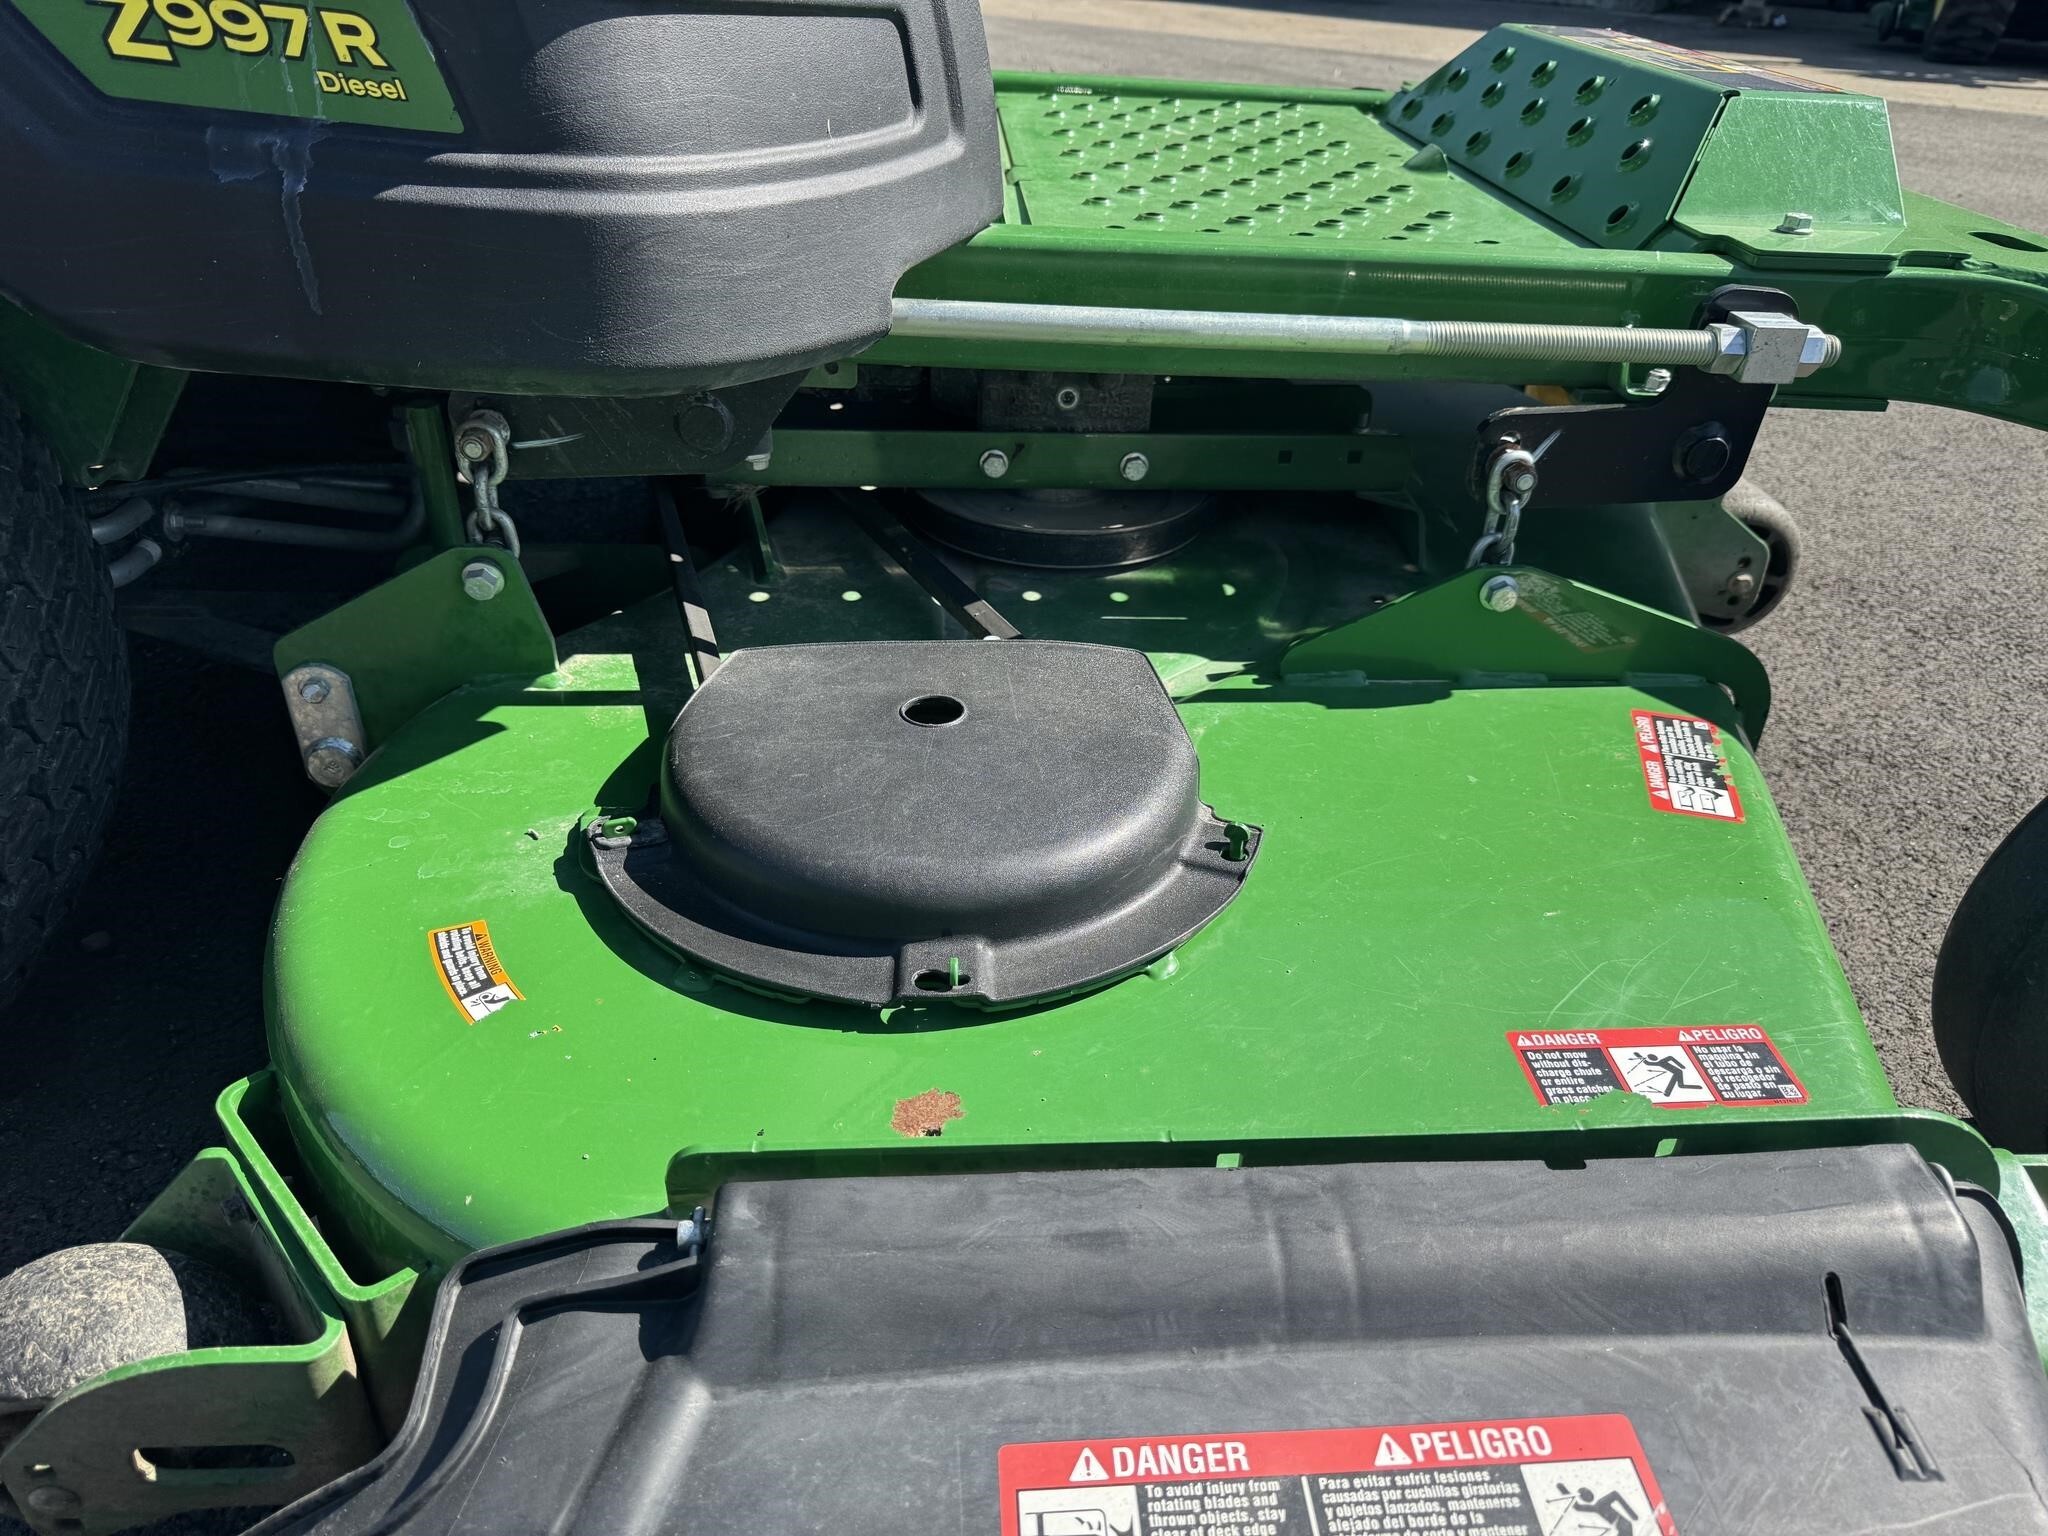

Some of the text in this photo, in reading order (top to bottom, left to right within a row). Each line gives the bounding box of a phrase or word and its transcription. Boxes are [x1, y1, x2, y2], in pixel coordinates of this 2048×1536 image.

[315, 70, 408, 100] Diesel
[1645, 761, 1665, 788] DANGER
[478, 941, 502, 975] WARNING
[1531, 1033, 1602, 1046] DANGER
[1690, 1028, 1762, 1041] PELIGRO
[1527, 1051, 1587, 1060] Do not mow
[1692, 1044, 1745, 1054] No usar la
[1743, 1051, 1760, 1059] sin
[1531, 1059, 1591, 1068] without dis-
[1714, 1060, 1738, 1068] tubo
[1739, 1059, 1753, 1067] de
[1536, 1067, 1602, 1078] charge chute
[1708, 1067, 1754, 1077] descarga
[1764, 1065, 1781, 1073] sin
[1541, 1077, 1585, 1086] or entire
[1711, 1074, 1776, 1084] el recogedor
[1545, 1085, 1614, 1097] grass catcher
[1717, 1081, 1778, 1092] de pasto en
[1721, 1090, 1766, 1099] su lugar.
[1410, 1425, 1552, 1462] PELIGRO
[1112, 1441, 1250, 1477] DANGER
[1319, 1470, 1490, 1490] Para evitar sufrir lesiones
[1145, 1479, 1280, 1498] To avoid injury from
[1322, 1482, 1520, 1504] causadas por cuchillas giratorias
[1147, 1493, 1278, 1513] rotating blades and
[1325, 1496, 1521, 1520] y objetos lanzados, mantenerse
[1149, 1507, 1286, 1528] thrown objects, stay
[1328, 1509, 1484, 1533] alejado del borde de la
[1190, 1525, 1204, 1536] of
[1208, 1523, 1240, 1536] deck
[1243, 1521, 1277, 1536] edge
